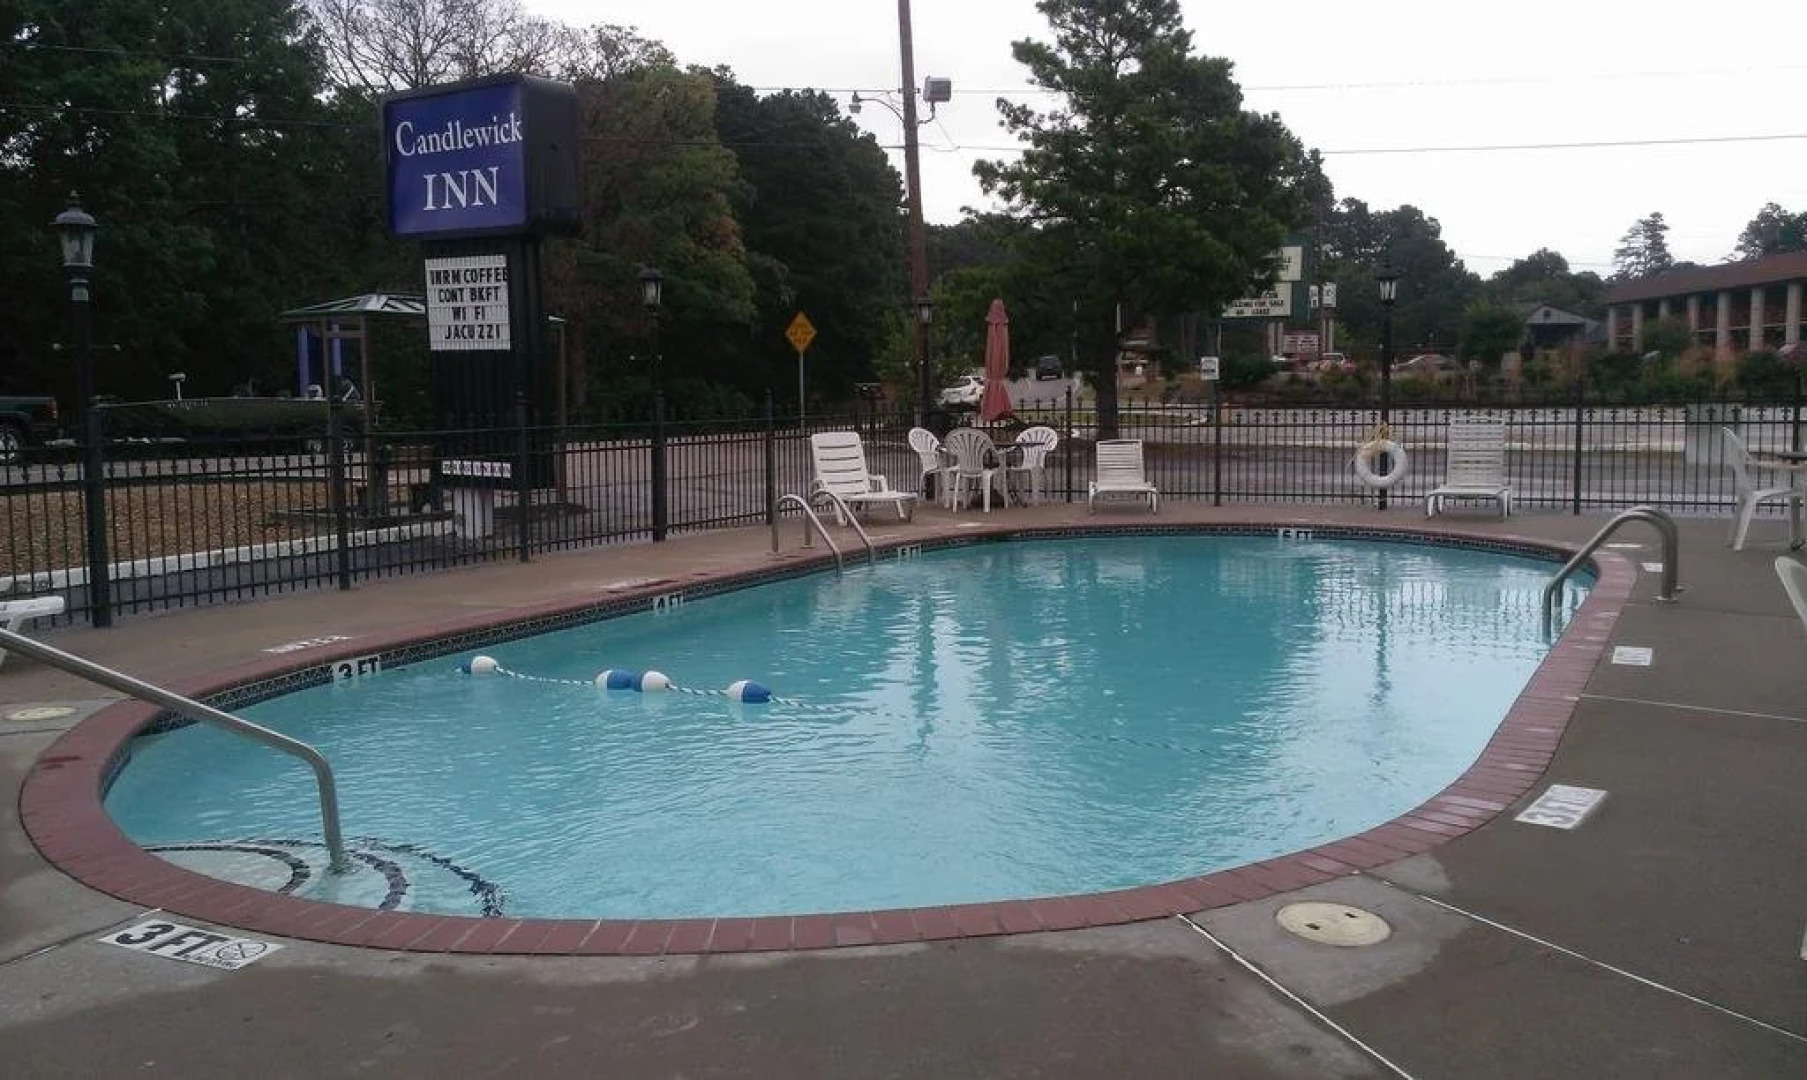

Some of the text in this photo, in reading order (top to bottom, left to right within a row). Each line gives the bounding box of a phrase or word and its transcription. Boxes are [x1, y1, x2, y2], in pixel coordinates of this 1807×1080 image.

[395, 112, 523, 156] Candlewick
[423, 166, 499, 211] INN
[463, 267, 508, 283] COFFEE
[439, 286, 501, 303] CONT BKFT
[452, 305, 486, 321] WI FI
[445, 324, 500, 340] JACUZZI
[357, 656, 379, 675] FT
